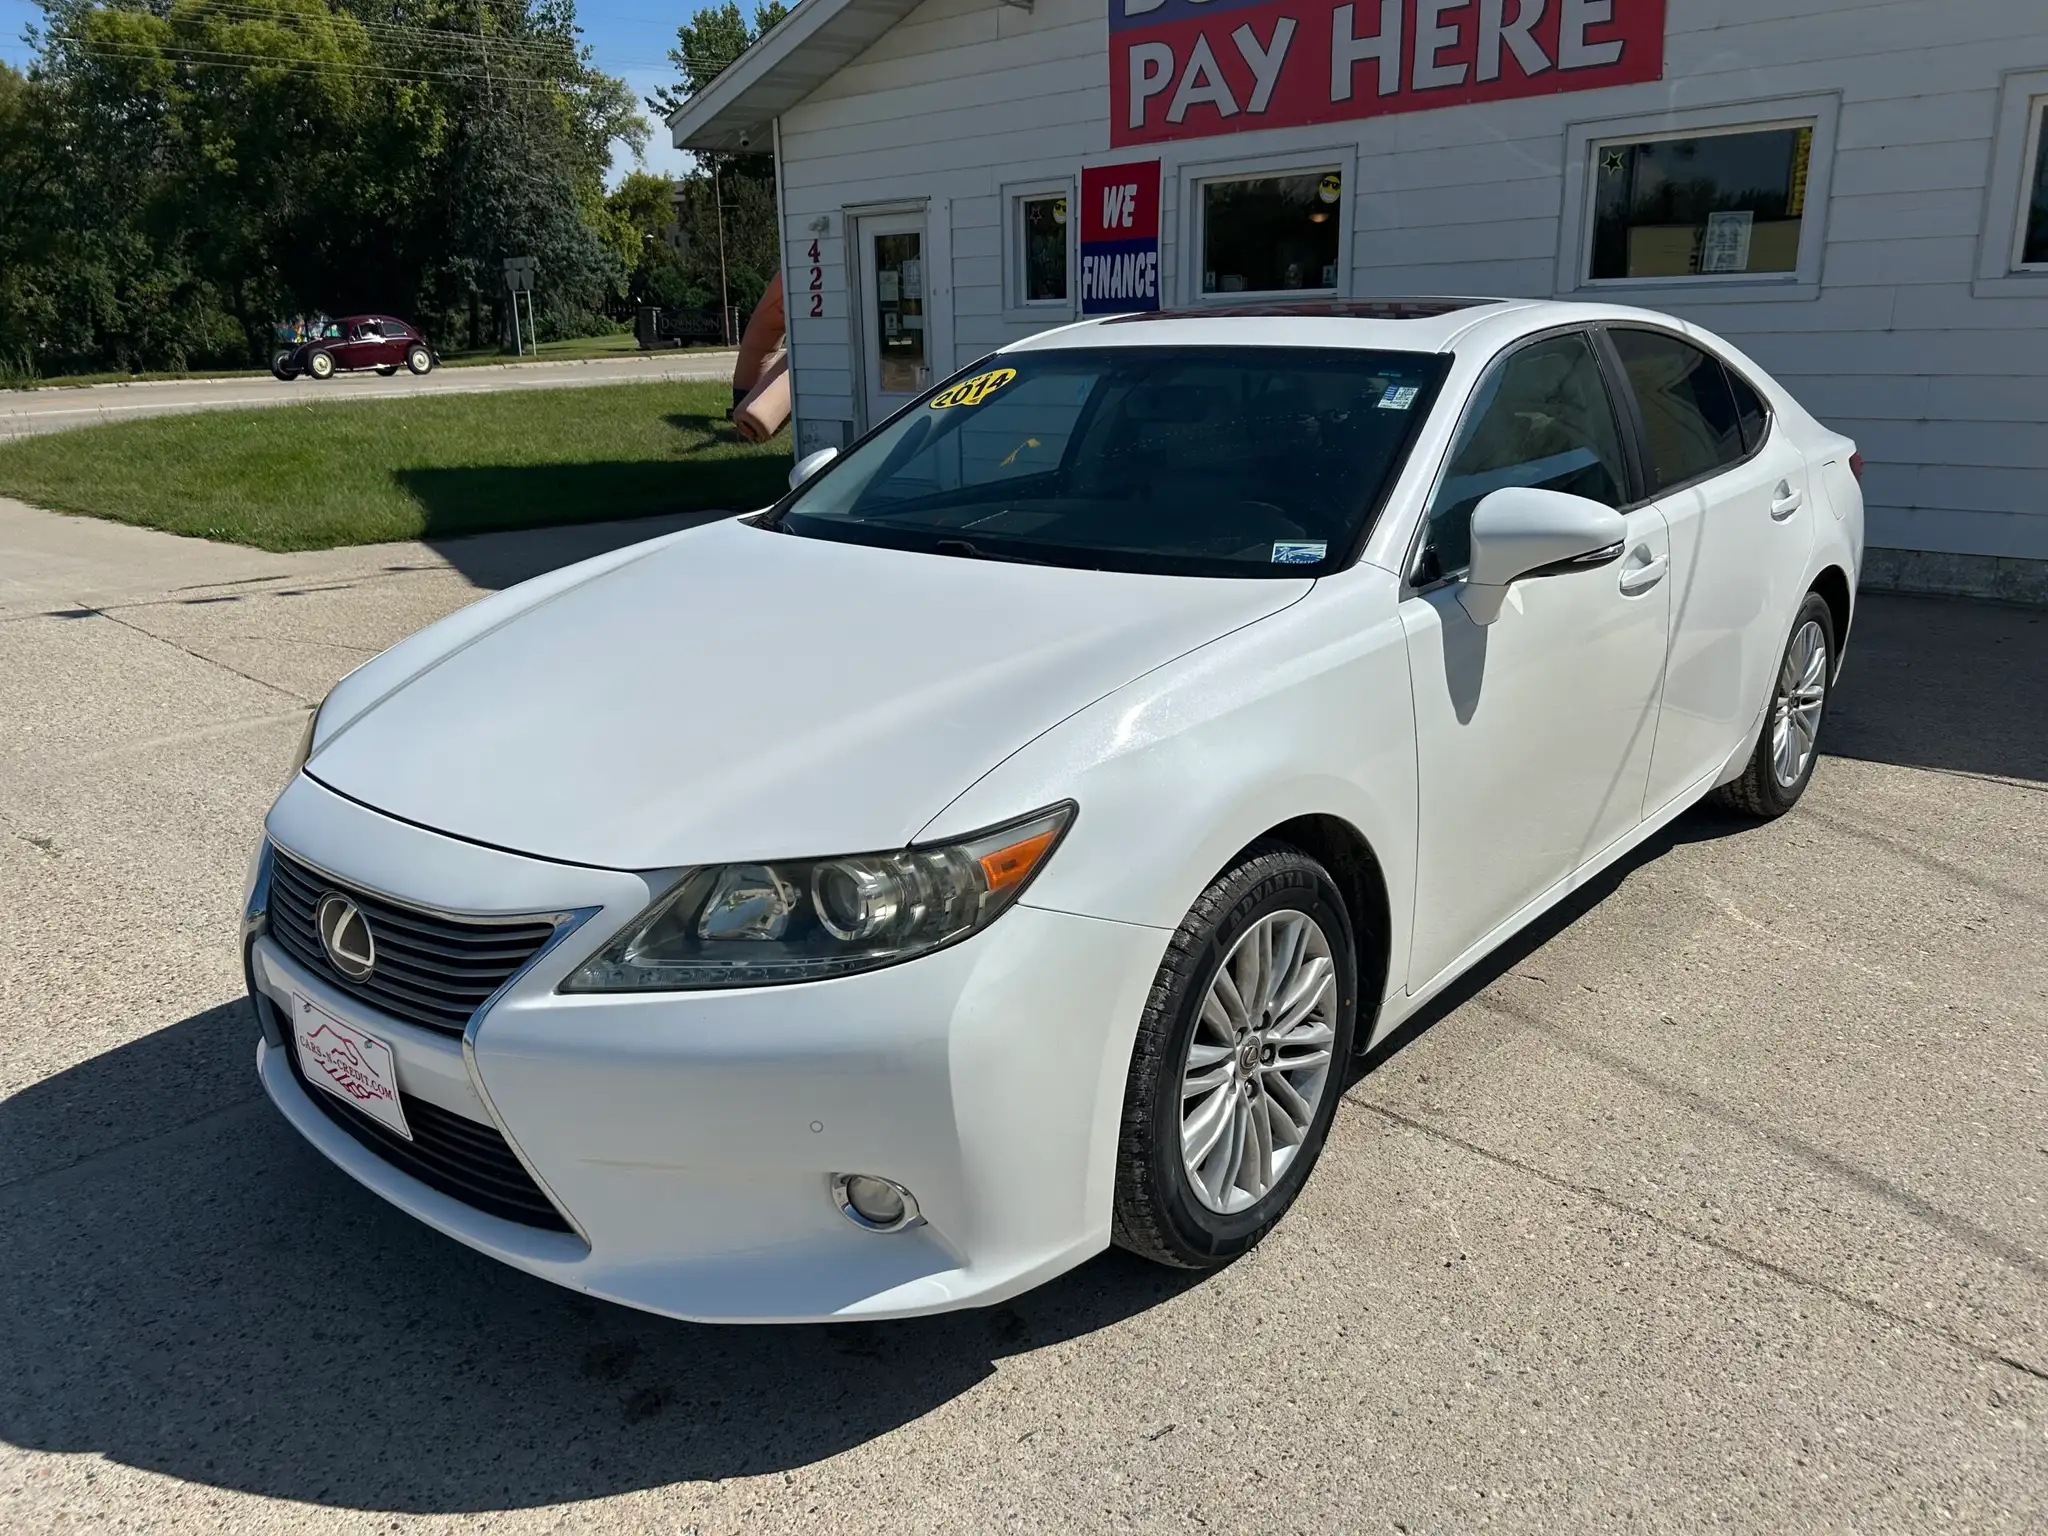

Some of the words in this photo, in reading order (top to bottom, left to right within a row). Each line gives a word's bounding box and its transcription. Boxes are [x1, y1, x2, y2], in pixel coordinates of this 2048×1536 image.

[1127, 16, 1299, 129] PAY
[1330, 0, 1626, 102] HERE
[1102, 184, 1138, 229] WE
[808, 239, 823, 317] 422
[1082, 251, 1157, 300] FINANCE
[934, 371, 1010, 407] 2014
[1228, 871, 1305, 930] ADVANTA
[299, 1035, 394, 1101] CARS-N-CREDIT.COM
